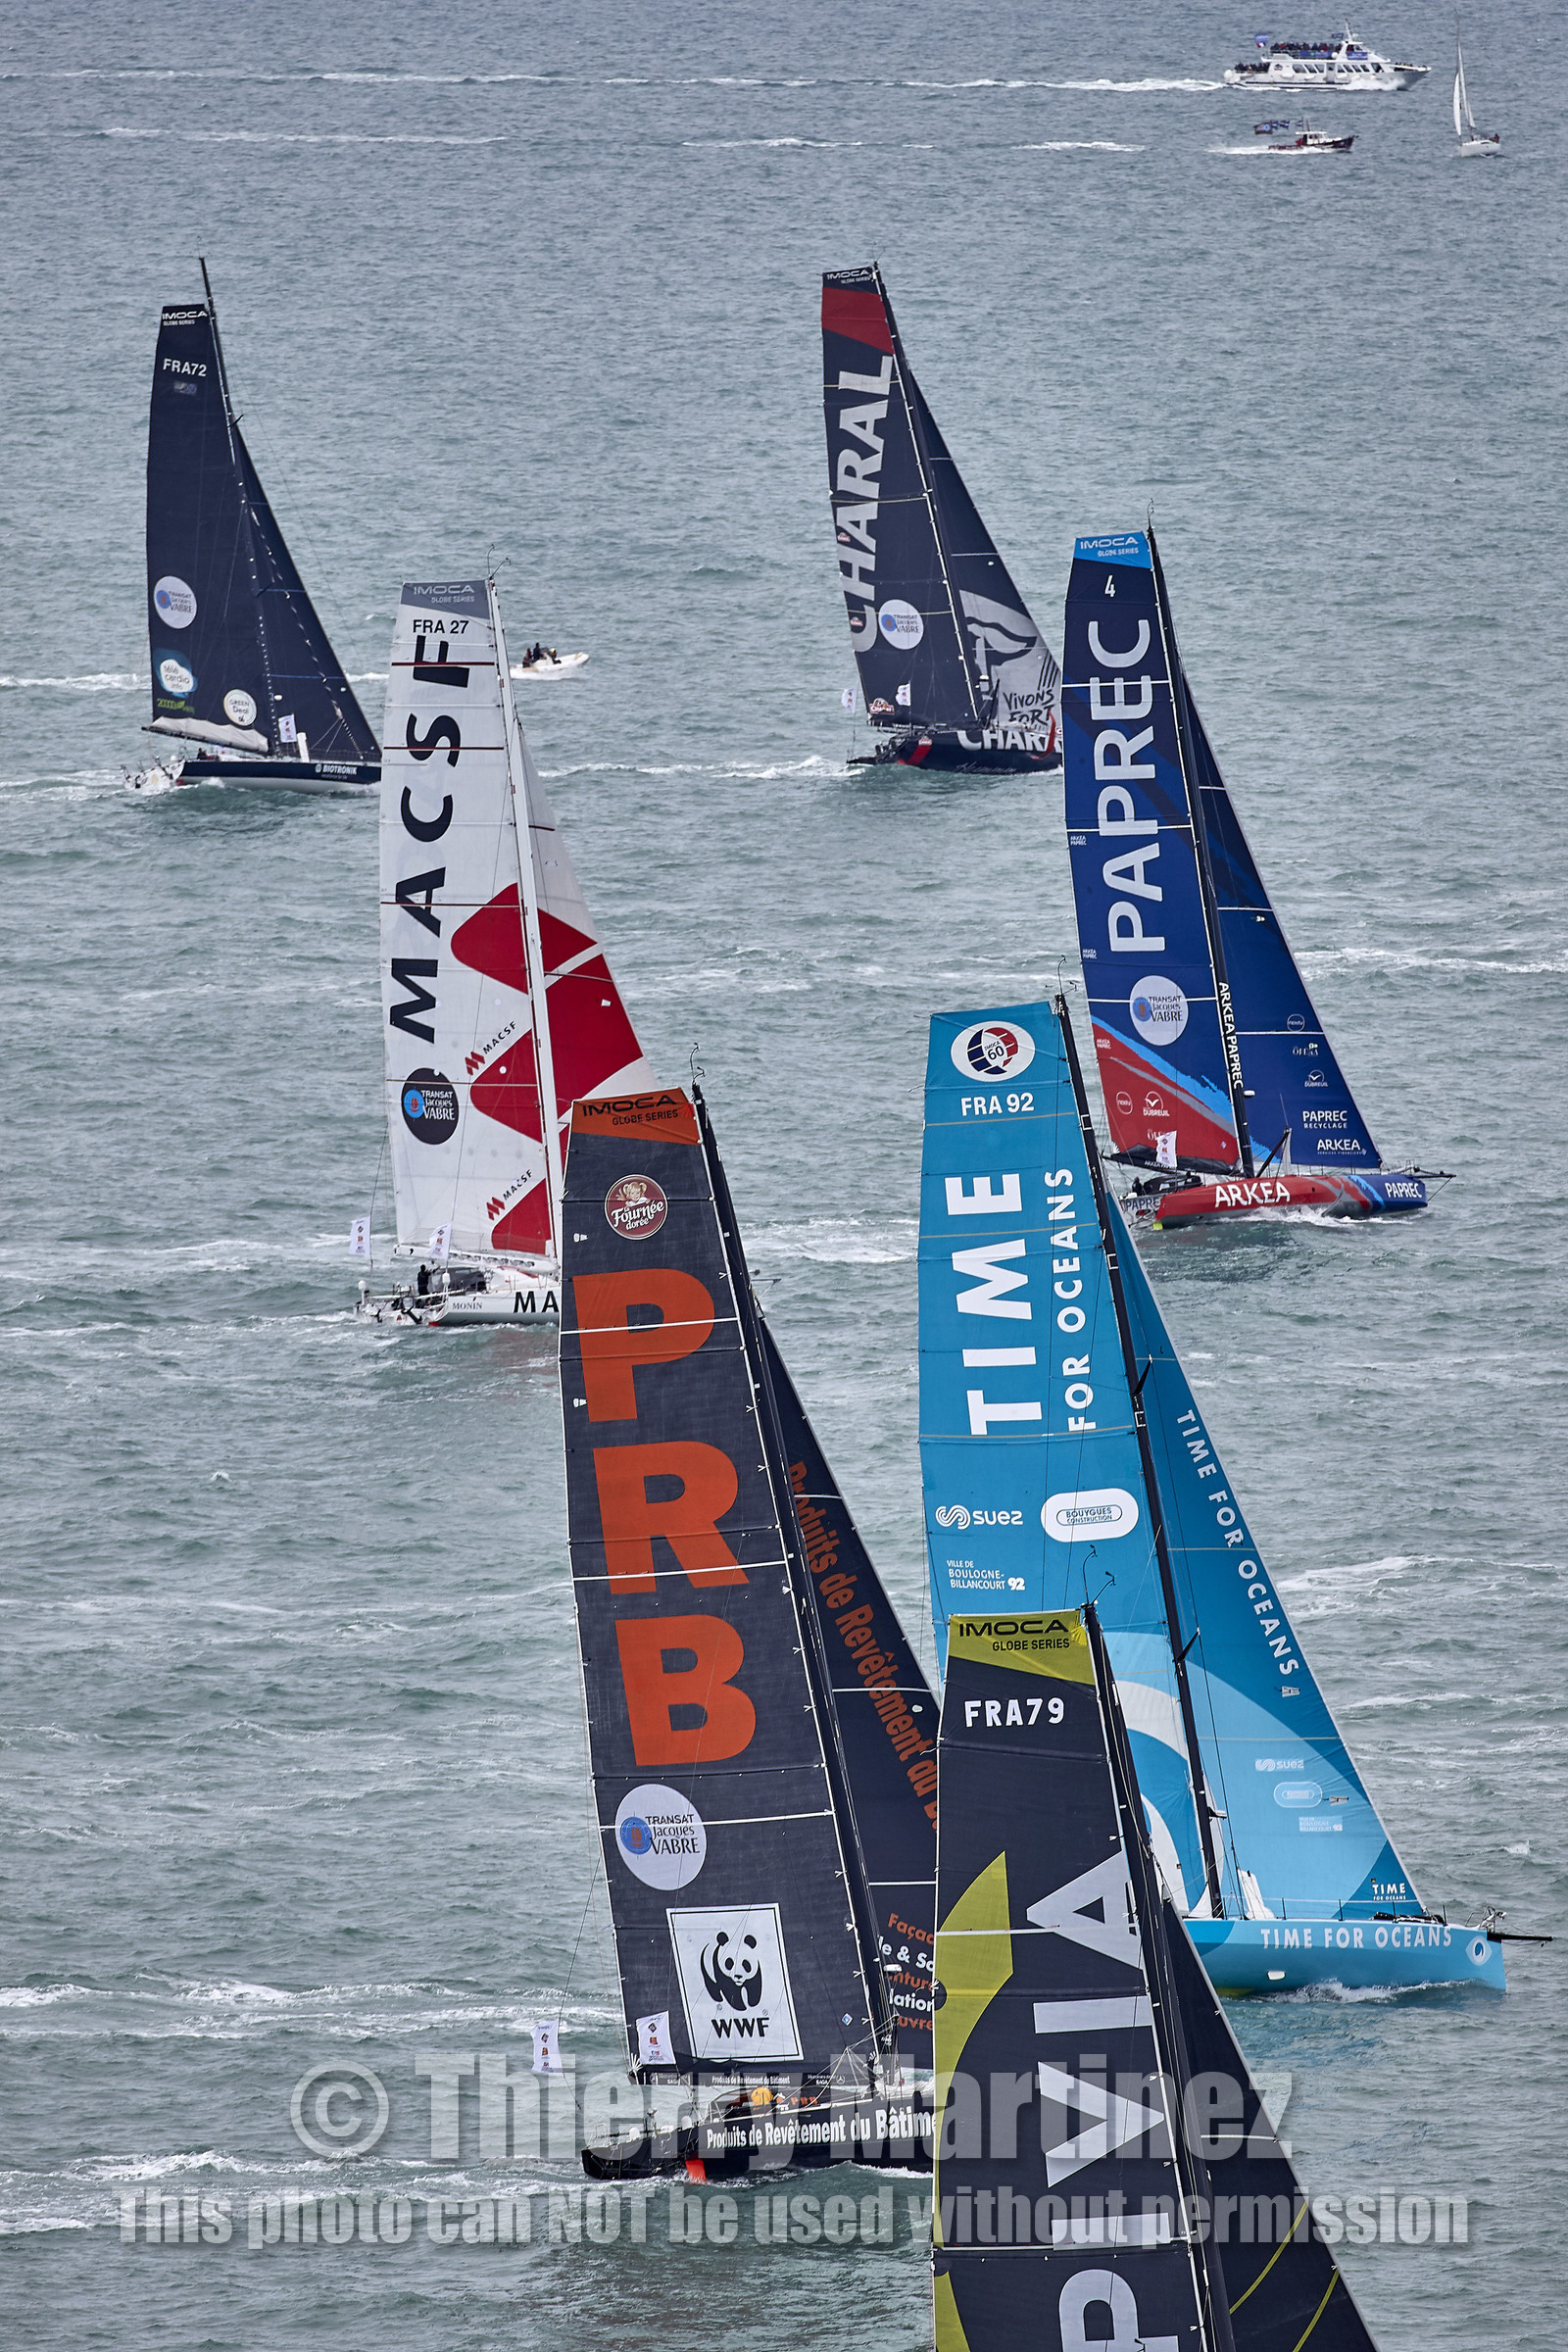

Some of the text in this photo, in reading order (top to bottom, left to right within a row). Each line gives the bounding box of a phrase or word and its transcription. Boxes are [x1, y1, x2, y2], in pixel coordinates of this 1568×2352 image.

[826, 270, 869, 279] IMOCA
[163, 311, 208, 319] IMOCA
[163, 358, 207, 377] FRA72
[1080, 536, 1138, 549] IMOCA
[1118, 547, 1139, 556] SERIES
[414, 585, 474, 595] IMOCA
[1104, 574, 1115, 598] 4
[413, 619, 469, 634] FRA 27
[896, 625, 919, 634] VABRE
[322, 765, 358, 775] BIOTRONIK
[1088, 618, 1165, 953] PAPREC
[390, 635, 469, 1044] MACSF
[1152, 1004, 1181, 1012] Jacques
[1151, 1010, 1183, 1022] VABRE
[482, 1020, 516, 1055] MACSF
[1218, 981, 1244, 1089] ARKEA PAPREC
[988, 1046, 1004, 1059] 60
[420, 1090, 454, 1099] TRANSAT
[424, 1098, 453, 1108] Jacques
[582, 1095, 677, 1116] IMOCA
[960, 1092, 1035, 1116] FRA 92
[422, 1105, 456, 1121] VABRE
[612, 1109, 679, 1126] GLOBE SERIES
[1302, 1110, 1348, 1122] PAPREC
[1317, 1139, 1360, 1151] ARKEA
[503, 1168, 533, 1200] MACSF
[1385, 1182, 1422, 1199] PAPREC
[1214, 1181, 1292, 1208] ARKEA
[1125, 1197, 1160, 1211] PAPRE
[611, 1200, 665, 1227] Fournée
[625, 1216, 649, 1231] dorée
[452, 1301, 483, 1310] MONIN
[945, 1173, 1043, 1436] TIME
[1044, 1168, 1097, 1432] FOR OCEANS
[572, 1268, 757, 1766] PRB
[1065, 1506, 1112, 1518] BOUYGUES
[1066, 1515, 1112, 1525] CONSTRUCTION
[1177, 1409, 1299, 1676] TIME FOR OCEANS
[948, 1569, 1004, 1580] BOULOGNE-
[818, 1572, 858, 1609] de
[950, 1579, 1005, 1591] BILLANCOURT
[1007, 1577, 1026, 1591] 92
[959, 1620, 1069, 1637] IMOCA
[992, 1638, 1070, 1651] GLOBE SERIES
[835, 1603, 934, 1763] Revêtement
[964, 1697, 1064, 1728] FRA79
[645, 1814, 695, 1825] TRANSAT
[653, 1826, 696, 1840] Jacques
[650, 1837, 701, 1855] VABRE
[1372, 1883, 1405, 1894] TIME
[1260, 1926, 1451, 1949] TIME FOR OCEANS
[915, 1952, 934, 1972] So
[710, 2017, 770, 2039] WWF
[707, 2106, 936, 2149] Produits de Revêtement du Bâtime
